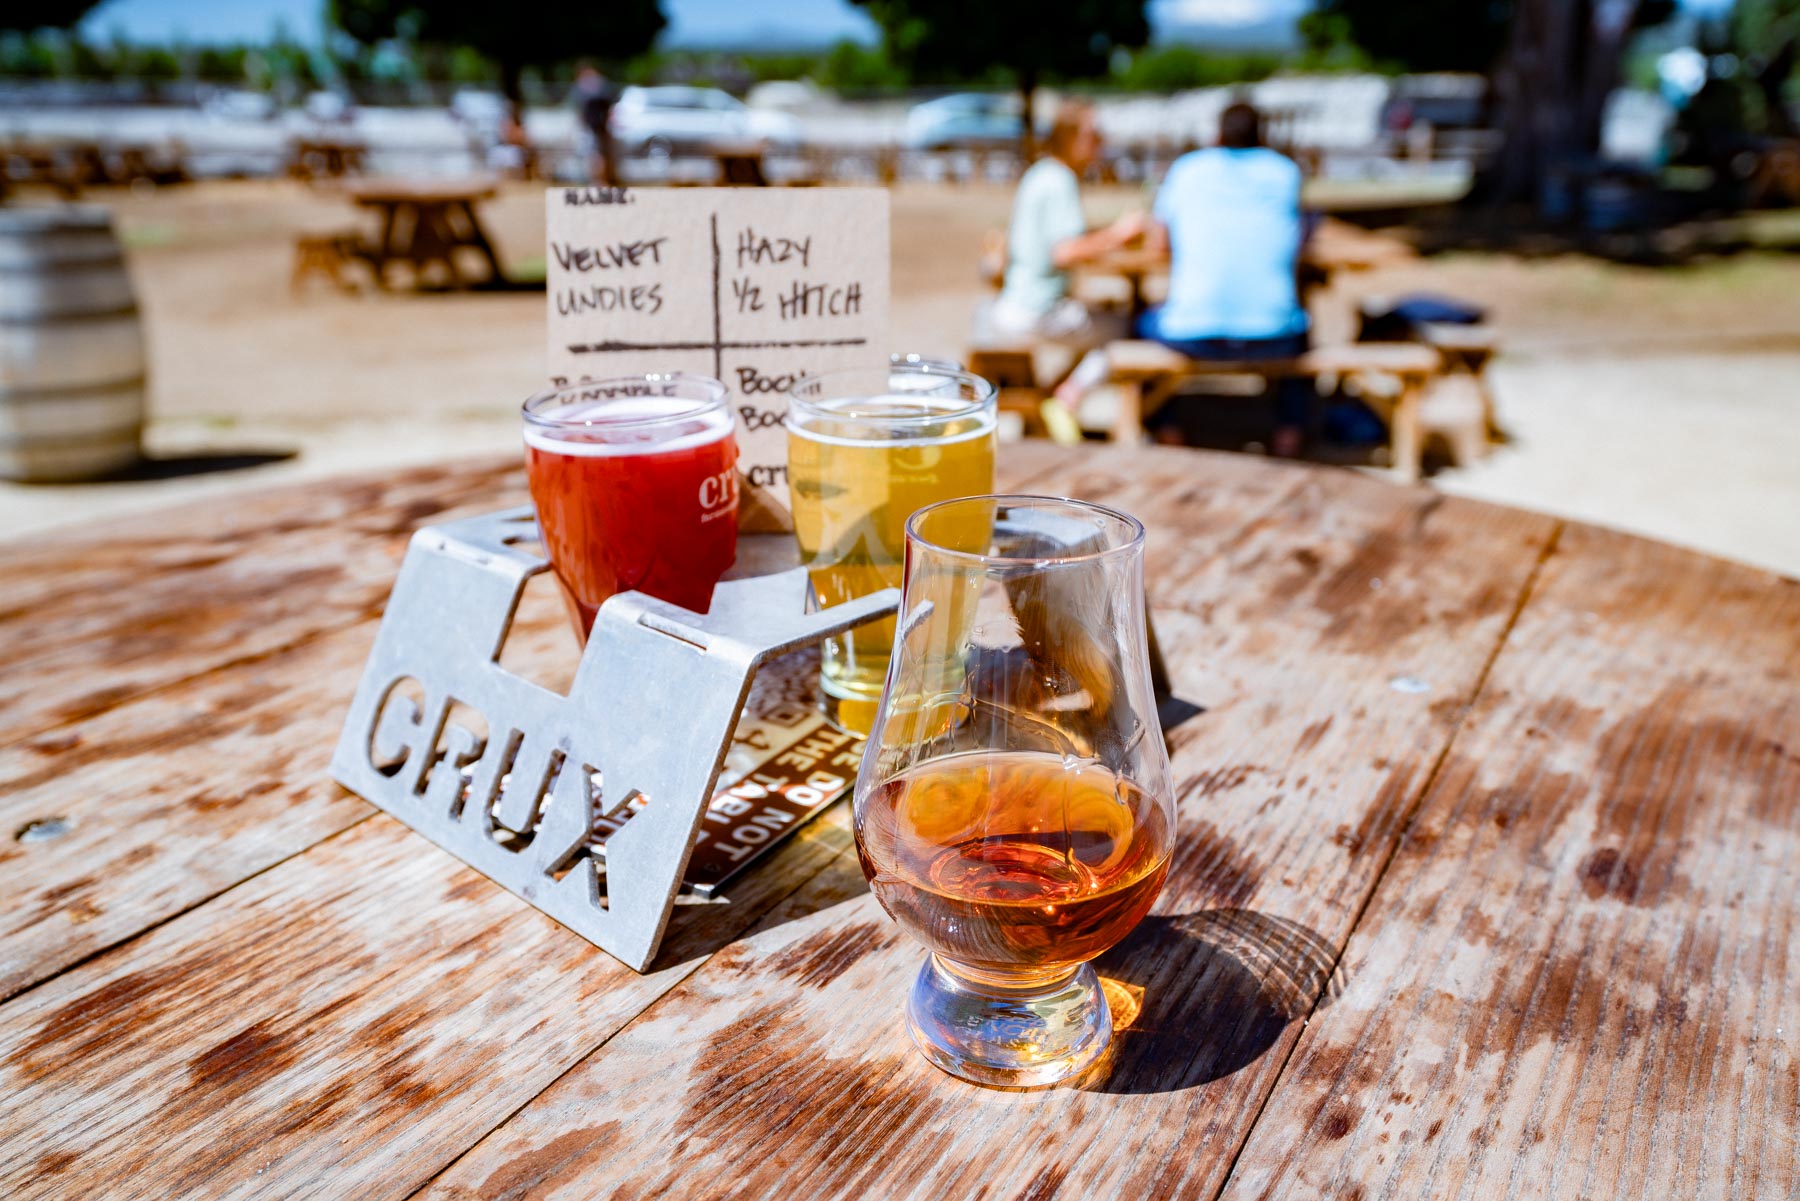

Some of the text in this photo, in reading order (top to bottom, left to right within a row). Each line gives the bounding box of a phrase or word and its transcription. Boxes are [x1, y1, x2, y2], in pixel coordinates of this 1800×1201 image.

[552, 237, 668, 273] VELVET
[737, 227, 812, 268] HAZY
[556, 283, 664, 316] UNDIES
[778, 282, 863, 320] HITCH
[775, 730, 852, 772] THE
[367, 674, 651, 912] CRUX
[696, 773, 790, 844] TABL
[714, 770, 846, 862] DO NOT
